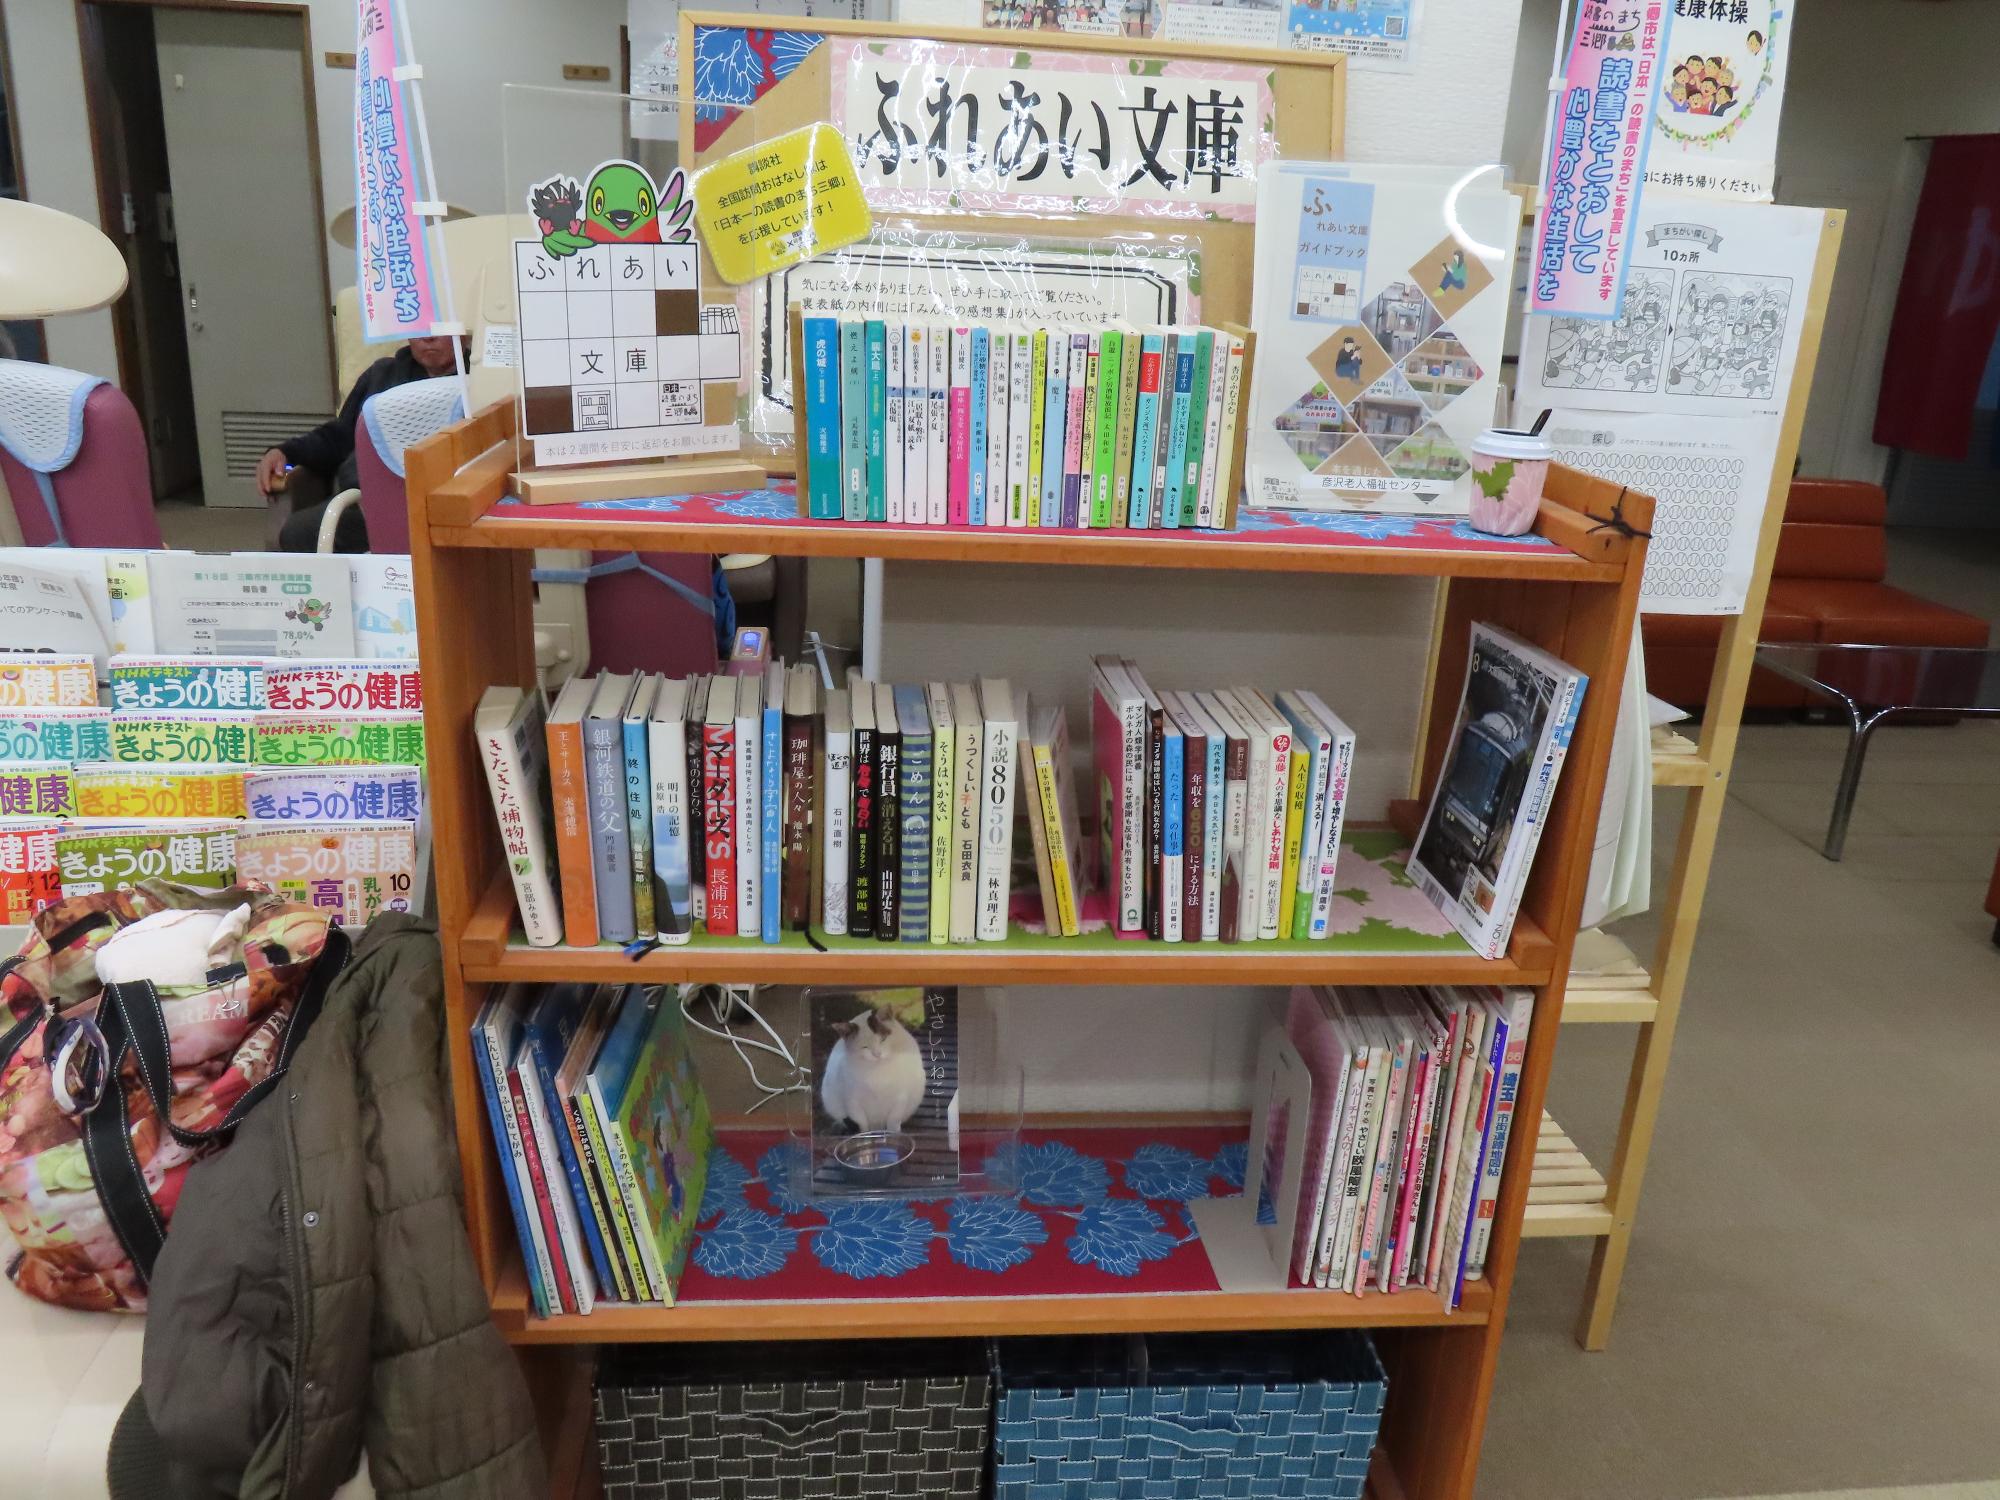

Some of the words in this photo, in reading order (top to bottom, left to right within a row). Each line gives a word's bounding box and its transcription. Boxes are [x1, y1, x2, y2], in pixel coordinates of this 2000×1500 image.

[857, 70, 1246, 195] ふれあい文庫
[1598, 0, 1662, 301] 郷市は「日本一の読書のまち」を宣言しています
[746, 152, 783, 174] 講談社
[1569, 57, 1633, 274] 読書をとおして
[1537, 87, 1589, 301] 心豊かな生活を
[1316, 220, 1369, 236] れあい文庫
[1662, 226, 1708, 240] まちがい探し
[528, 254, 690, 280] ふれあい
[1298, 242, 1367, 259] ガイドブック
[580, 349, 648, 374] 文庫
[814, 339, 828, 368] 虎の城
[1226, 366, 1240, 415] 杏のふむふむ
[1322, 477, 1431, 491] 彦沢老人福祉センター
[113, 667, 192, 679] NHKテキスト
[267, 671, 344, 685] NHKテキスト
[267, 671, 424, 711] きょうの健康
[115, 722, 193, 733] NHKテキスト
[115, 724, 256, 763] きょうの健
[258, 724, 337, 736] NHKテキスト
[258, 724, 425, 763] きょうの健康
[1133, 704, 1143, 772] マンガ人類学講義
[557, 730, 573, 787] 王とサーカス
[790, 737, 809, 815] 珈琲屋の人々
[909, 749, 925, 806] ごめん
[79, 777, 247, 818] きょうの健康
[251, 779, 420, 820] きょうの健康
[487, 736, 530, 857] きたきた捕物帖
[590, 728, 623, 835] 銀河鉄道の父
[626, 757, 643, 821] 終の住処
[688, 756, 703, 818] 雪のひとひら
[706, 740, 731, 840] マーダーズ
[934, 741, 950, 823] そうはいかない
[988, 728, 1010, 845] 小説8050
[666, 781, 681, 839] 明日の記憶
[832, 807, 843, 850] 石川直樹
[60, 836, 145, 850] NHKテキスト
[60, 832, 238, 879] きょうの健康
[237, 834, 412, 877] きょうの健康
[935, 836, 948, 879] 佐野洋子
[961, 838, 973, 882] 石田衣良
[40, 872, 62, 891] 12
[389, 873, 411, 892] 10
[710, 867, 730, 922] 長浦京
[986, 877, 1001, 927] 林真理子
[520, 881, 541, 930] 宮部みゆき
[926, 993, 945, 1095] やさしいねこ
[1498, 1071, 1520, 1102] 埼玉
